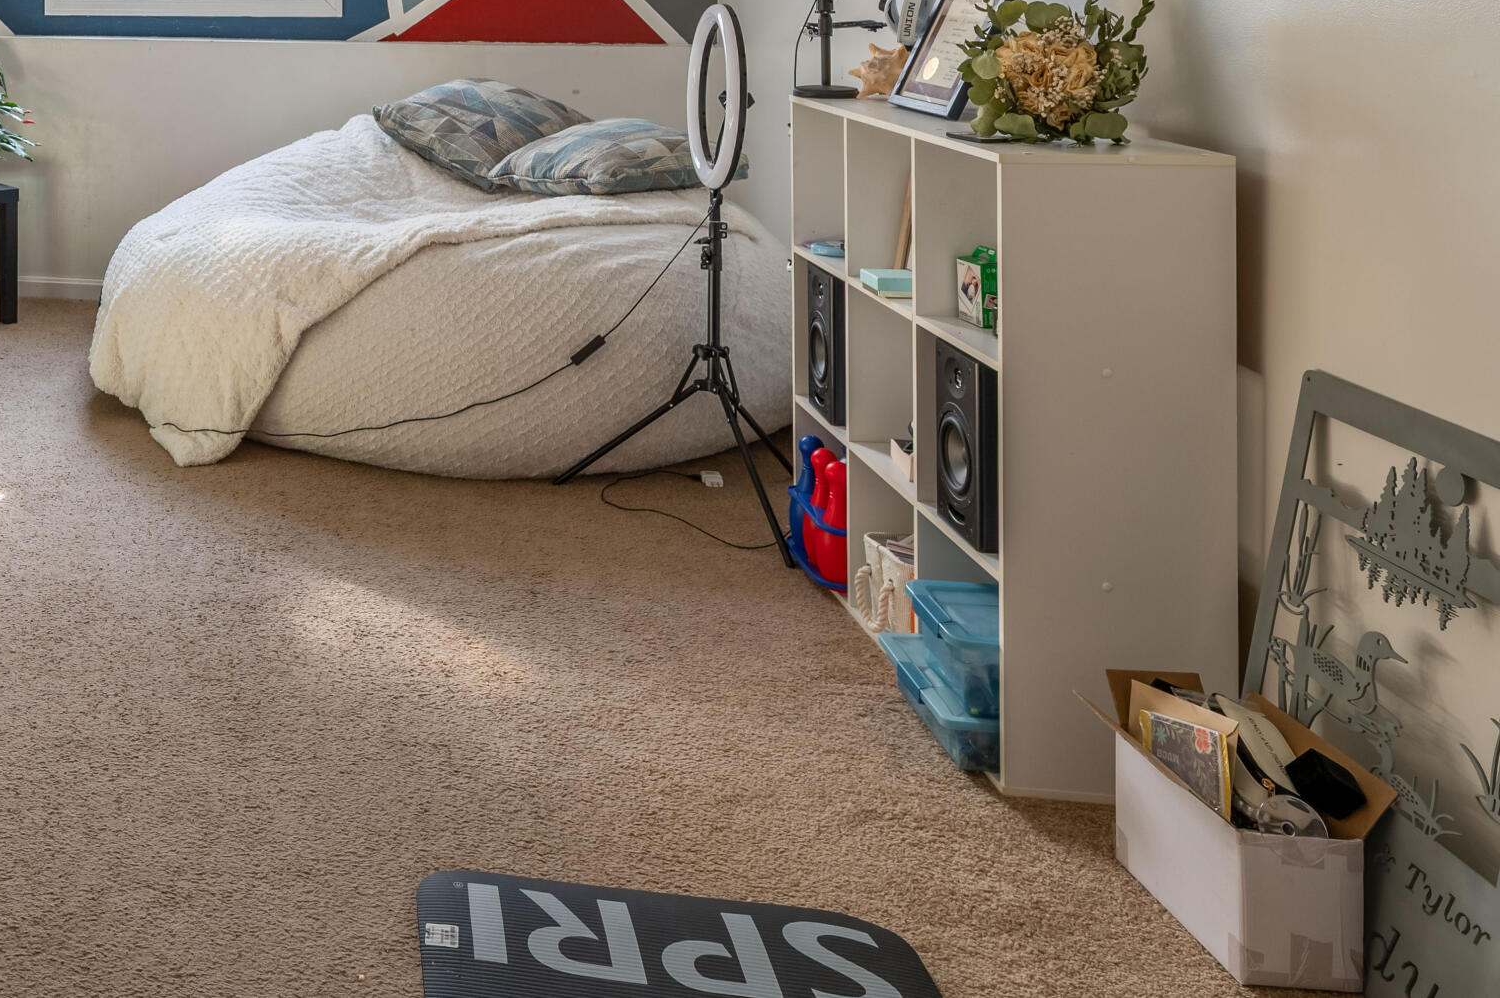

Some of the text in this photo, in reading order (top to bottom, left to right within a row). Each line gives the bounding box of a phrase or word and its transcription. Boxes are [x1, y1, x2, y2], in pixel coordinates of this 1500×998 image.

[903, 2, 916, 37] UNION
[467, 881, 906, 998] SPRI
[1405, 862, 1491, 947] Tylor
